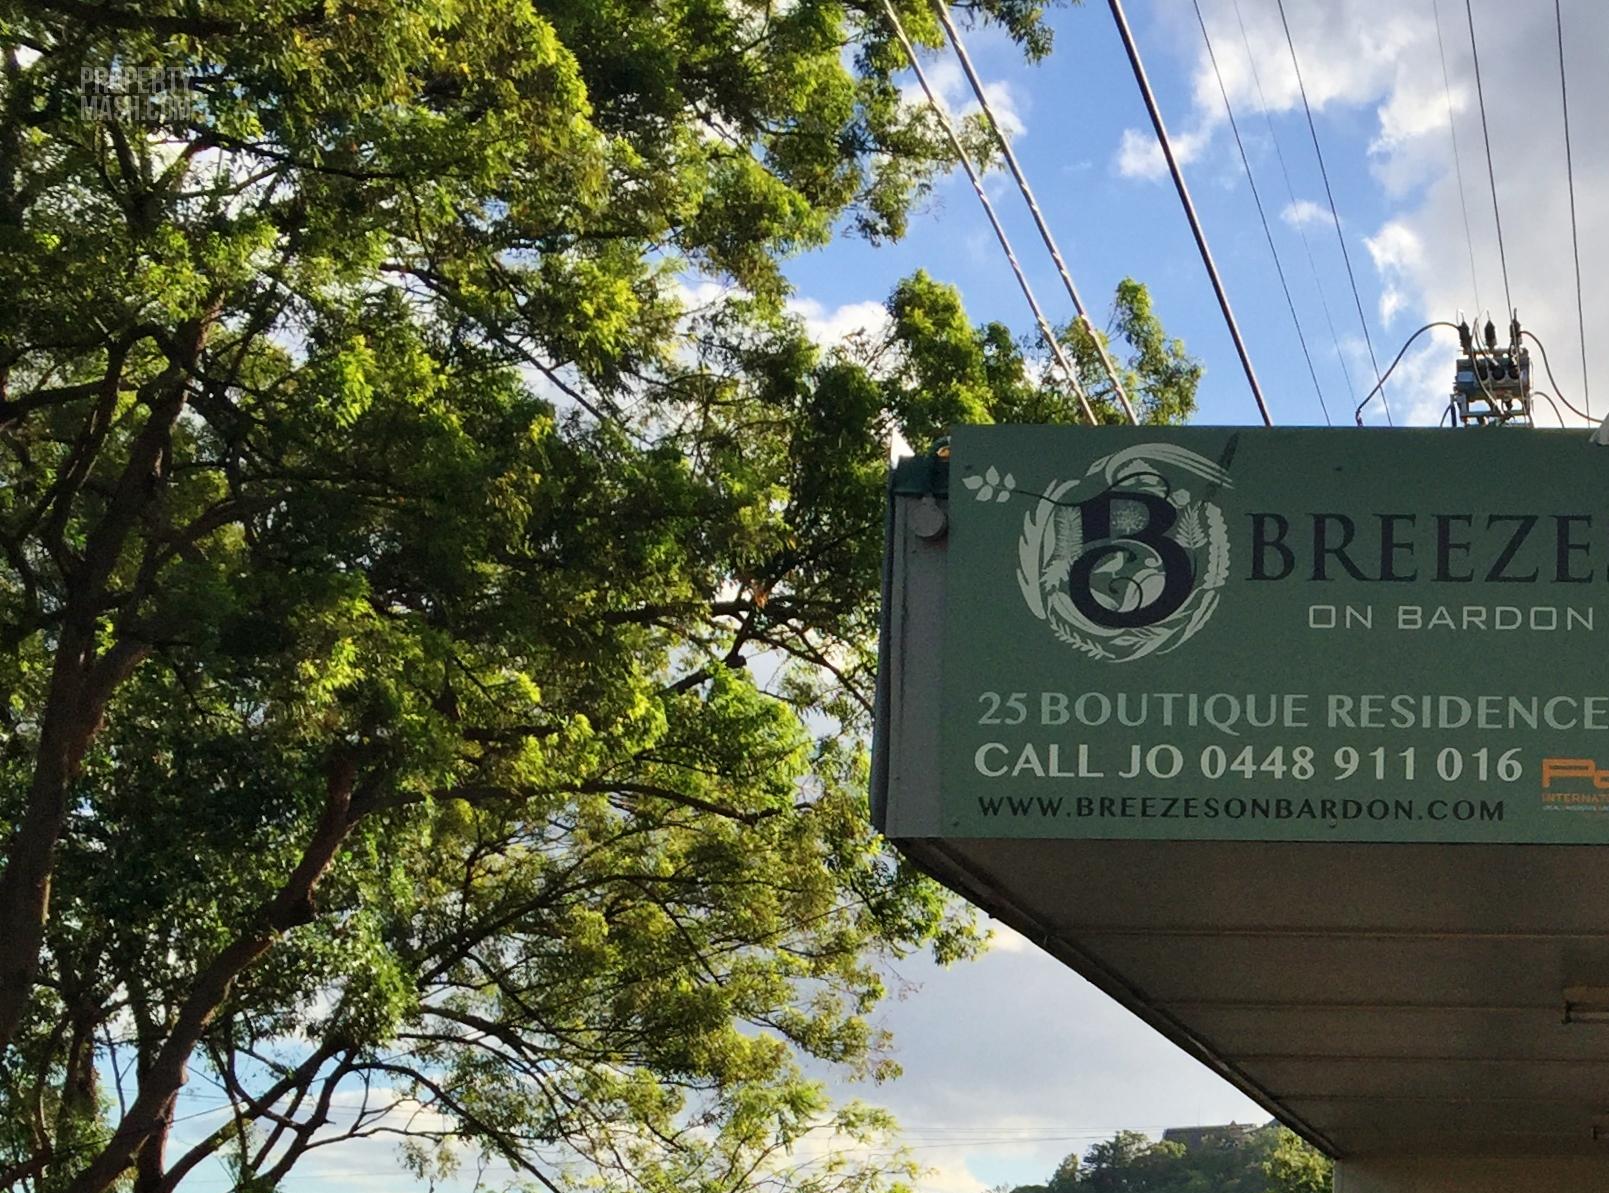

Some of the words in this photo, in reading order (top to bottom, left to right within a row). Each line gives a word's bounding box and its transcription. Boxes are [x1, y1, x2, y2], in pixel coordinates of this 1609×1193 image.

[1308, 604, 1372, 630] ON
[1398, 605, 1594, 632] BARDON
[978, 692, 1027, 727] 25
[1041, 691, 1309, 736] BOUTIQUE
[973, 742, 1104, 779] CALL
[1119, 743, 1184, 779] JO
[1200, 746, 1315, 781] 0448
[1333, 747, 1416, 781] 911
[1437, 747, 1523, 782] 016
[976, 796, 1505, 822] WWW.BREEZESONBARDON.COM
